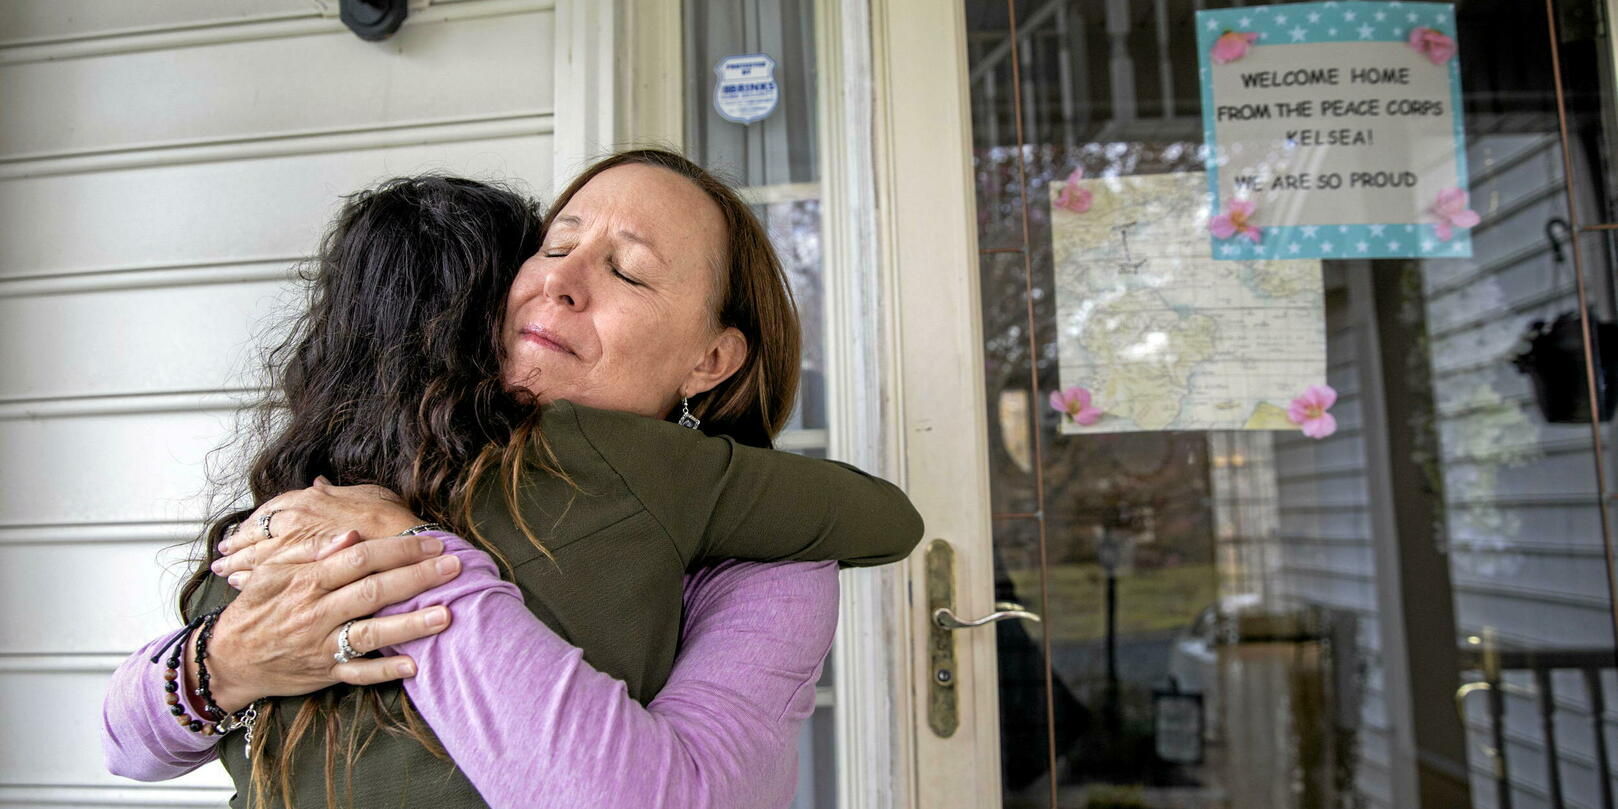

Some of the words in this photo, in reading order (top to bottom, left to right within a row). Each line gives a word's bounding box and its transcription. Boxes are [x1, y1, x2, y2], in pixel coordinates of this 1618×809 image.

[1241, 68, 1340, 88] WELCOME
[1351, 68, 1410, 84] HOME
[1217, 103, 1271, 121] FROM
[1275, 101, 1313, 117] THE
[1321, 100, 1380, 116] PEACE
[1386, 100, 1443, 116] CORPS
[1286, 130, 1373, 146] KELSEA!
[1234, 176, 1263, 191] WE
[1272, 174, 1310, 190] ARE
[1316, 173, 1342, 189] SO
[1351, 172, 1417, 188] PROUD
